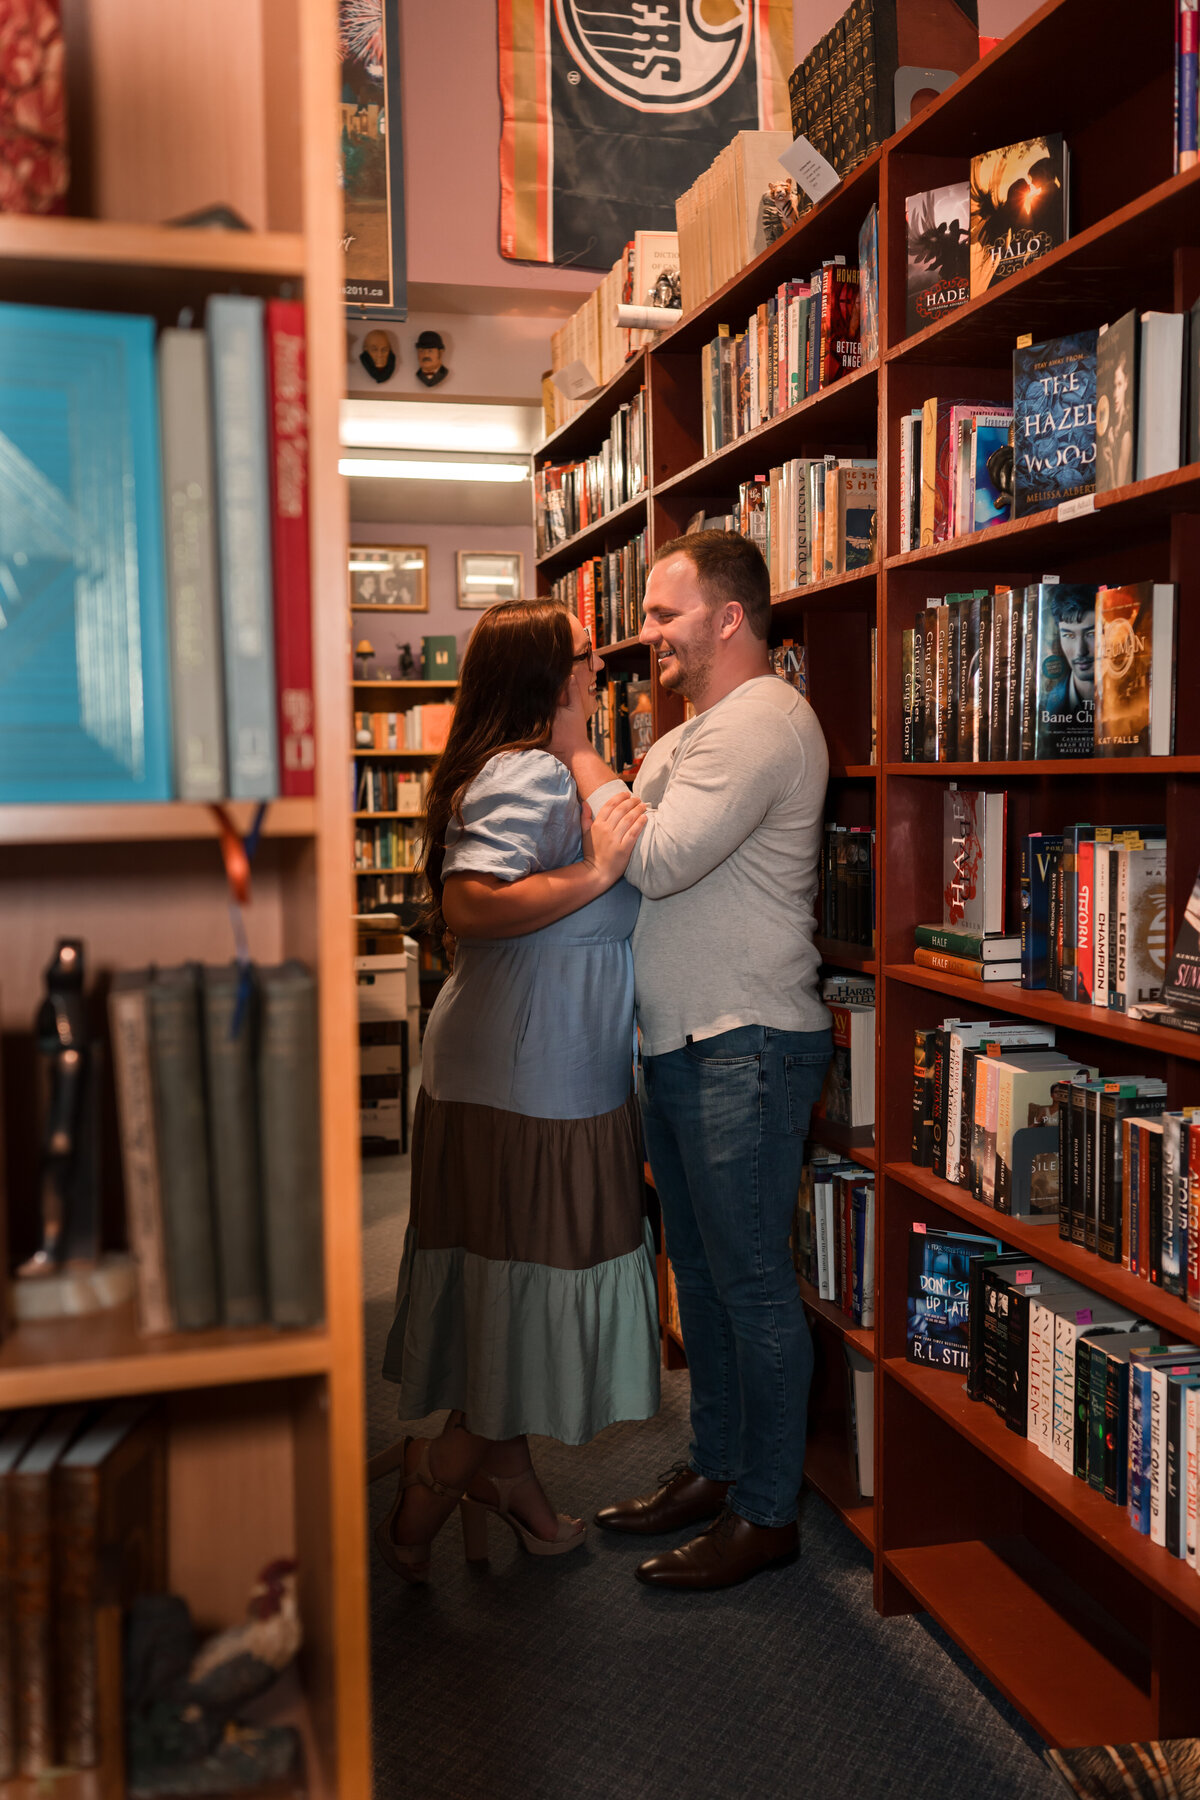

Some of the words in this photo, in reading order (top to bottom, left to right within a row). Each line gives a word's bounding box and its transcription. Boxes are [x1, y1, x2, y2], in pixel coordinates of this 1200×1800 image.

[991, 238, 1040, 261] HALO
[927, 288, 969, 306] HADE
[1040, 372, 1080, 396] THE
[1024, 404, 1096, 437] HAZEL
[1024, 442, 1096, 473] WOOD
[1026, 490, 1062, 503] MELISSA
[994, 614, 1002, 676] Clockwork
[915, 666, 922, 681] of
[904, 673, 912, 700] City
[1023, 667, 1032, 734] Chronicles
[1041, 710, 1072, 723] Bane
[1098, 737, 1112, 745] KAT
[1113, 736, 1140, 744] FALLS
[1078, 886, 1089, 948] THORN
[932, 936, 948, 948] HALF
[1109, 911, 1117, 984] PRODIGY
[1118, 912, 1126, 982] LEGEND
[932, 956, 948, 970] HALF
[838, 986, 875, 996] HARRY
[1162, 1150, 1174, 1258] DIVERGENT
[1178, 1176, 1188, 1230] FOUR
[1188, 1168, 1200, 1280] ALLEGIANT
[920, 1275, 956, 1296] DON'T
[926, 1296, 940, 1312] UP
[914, 1341, 926, 1360] R.
[928, 1344, 939, 1362] L.
[1030, 1328, 1041, 1414] FALLEN
[1041, 1337, 1050, 1424] FALLEN
[1054, 1346, 1064, 1434] FALLEN
[1063, 1352, 1074, 1440] FALLEN
[1152, 1390, 1160, 1415] ON
[1032, 1413, 1038, 1426] 1
[1042, 1422, 1048, 1437] 2
[1152, 1418, 1160, 1445] THE
[1054, 1432, 1061, 1446] 3
[1064, 1438, 1071, 1453] 4
[1150, 1450, 1160, 1493] COME
[1150, 1496, 1158, 1516] UP
